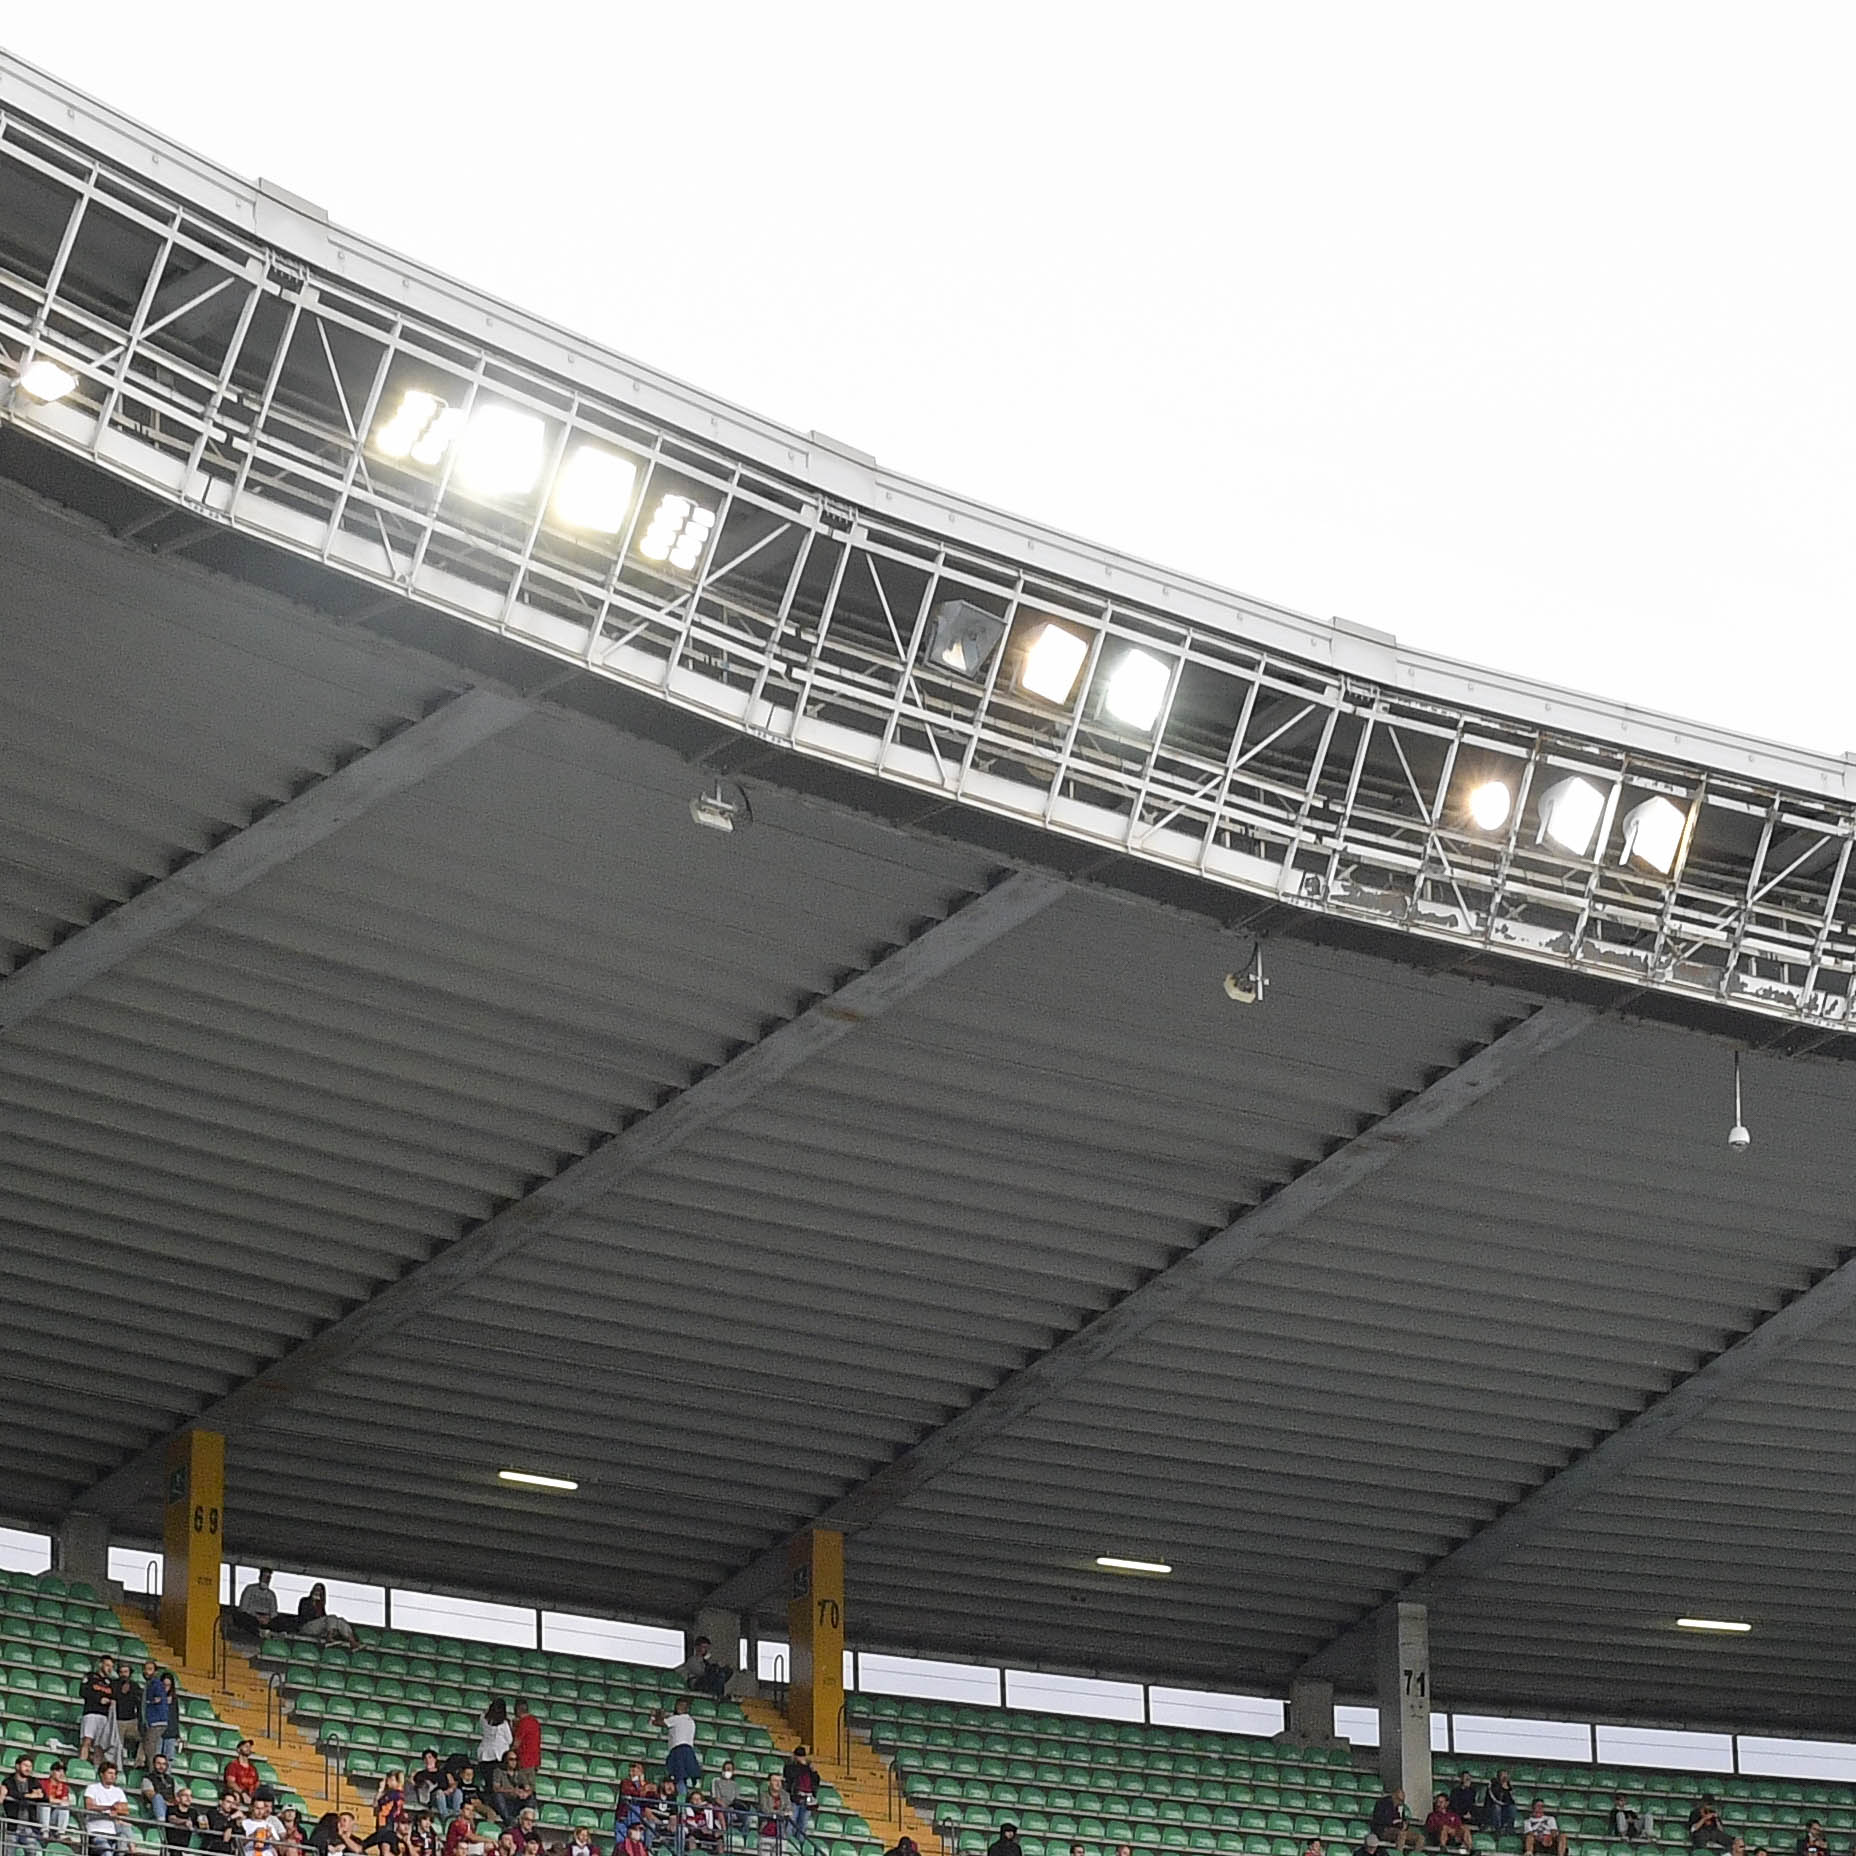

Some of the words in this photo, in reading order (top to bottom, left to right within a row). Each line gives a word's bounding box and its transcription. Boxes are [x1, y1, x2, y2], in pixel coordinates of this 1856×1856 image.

[194, 1506, 218, 1534] 69
[817, 1600, 840, 1628] 70
[1404, 1669, 1425, 1697] 71
